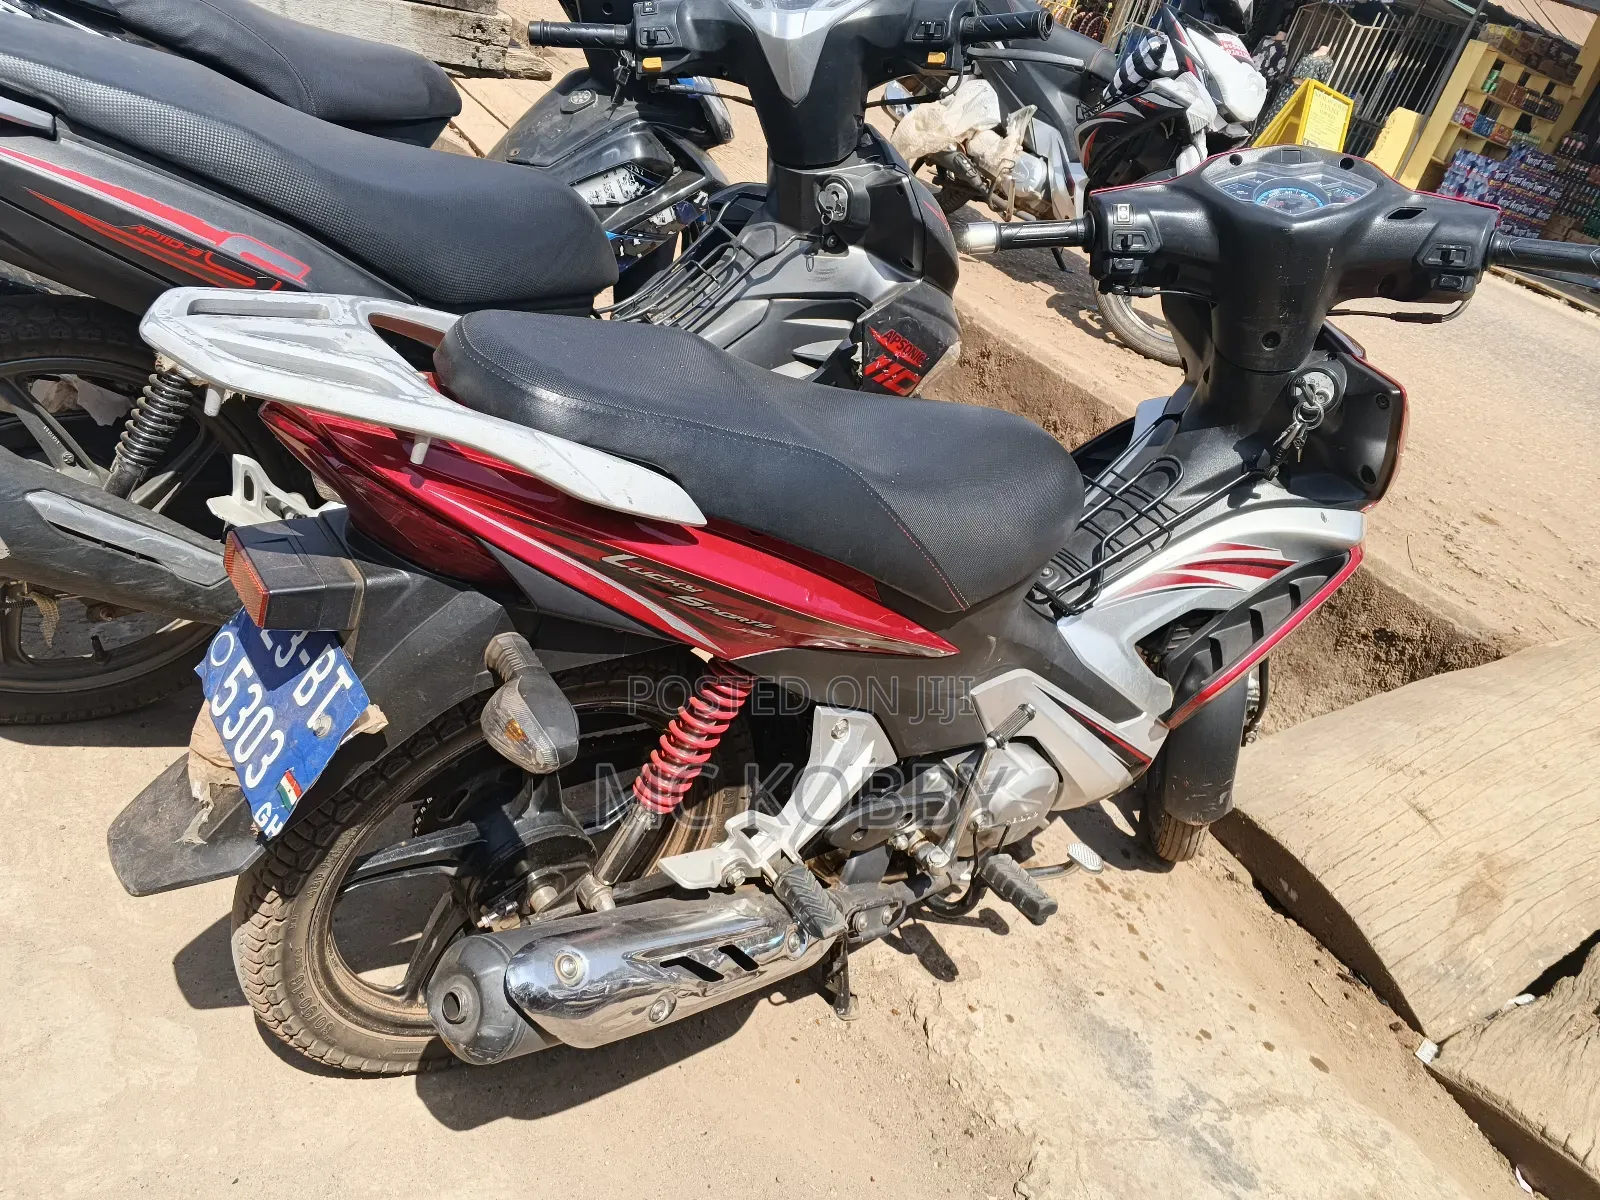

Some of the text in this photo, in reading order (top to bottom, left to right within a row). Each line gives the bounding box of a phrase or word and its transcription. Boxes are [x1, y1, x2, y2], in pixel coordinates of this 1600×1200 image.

[882, 329, 928, 364] APSONIC
[211, 656, 285, 789] 5303
[254, 801, 284, 839] GH
